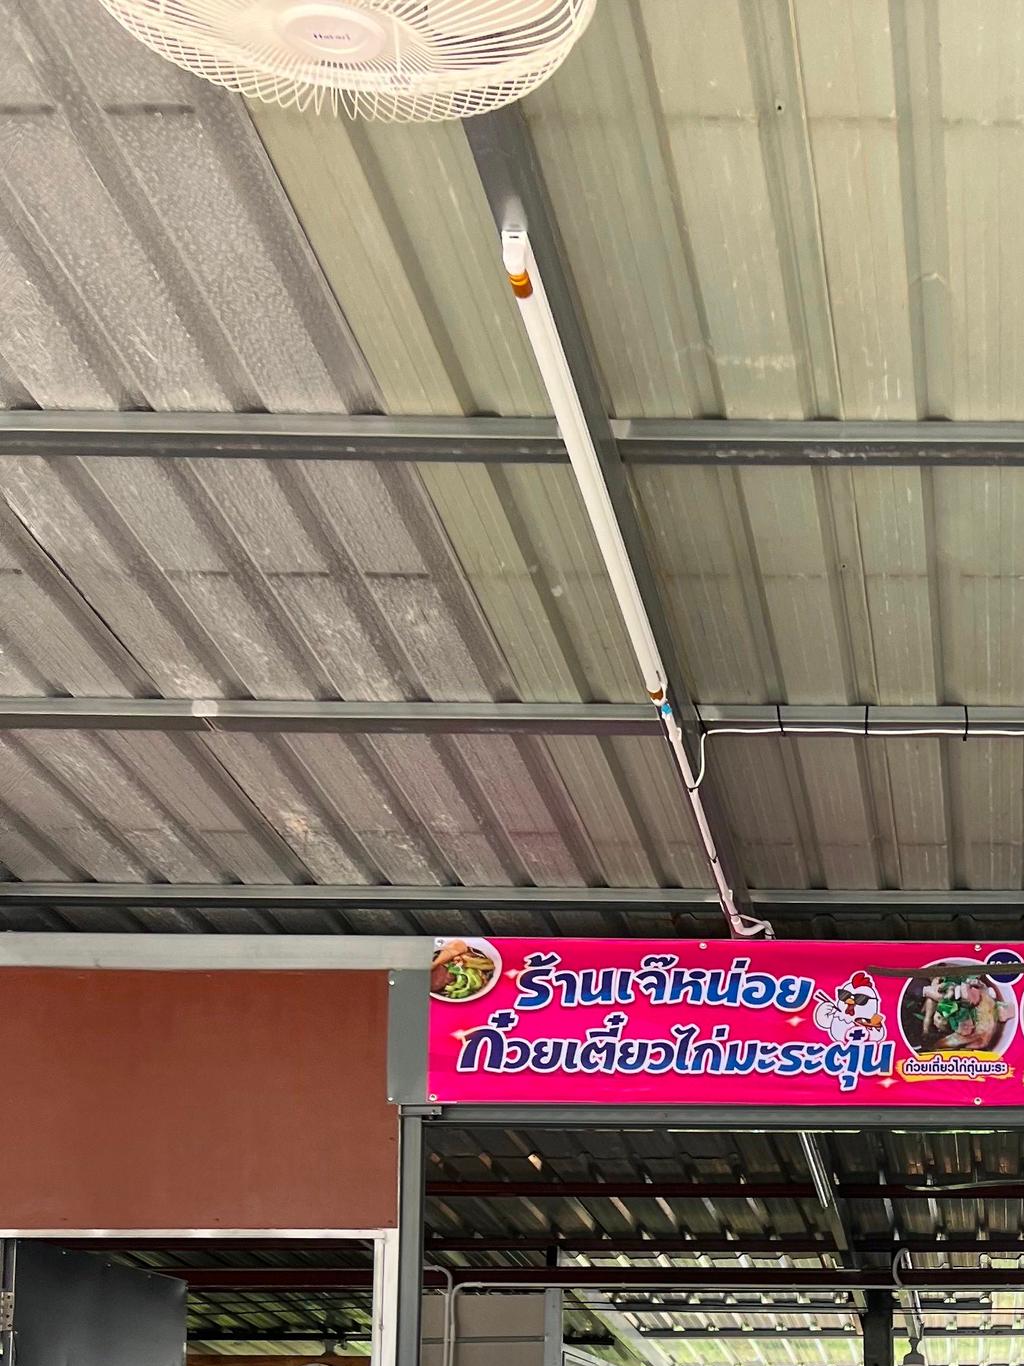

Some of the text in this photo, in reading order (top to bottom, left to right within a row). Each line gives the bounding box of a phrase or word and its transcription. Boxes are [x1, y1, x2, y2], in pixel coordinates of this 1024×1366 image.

[516, 953, 813, 1009] ร้านเจ๊หน่อย
[458, 1010, 894, 1089] ก๋วยเตี๋ยวไก่มะระตุ๋น
